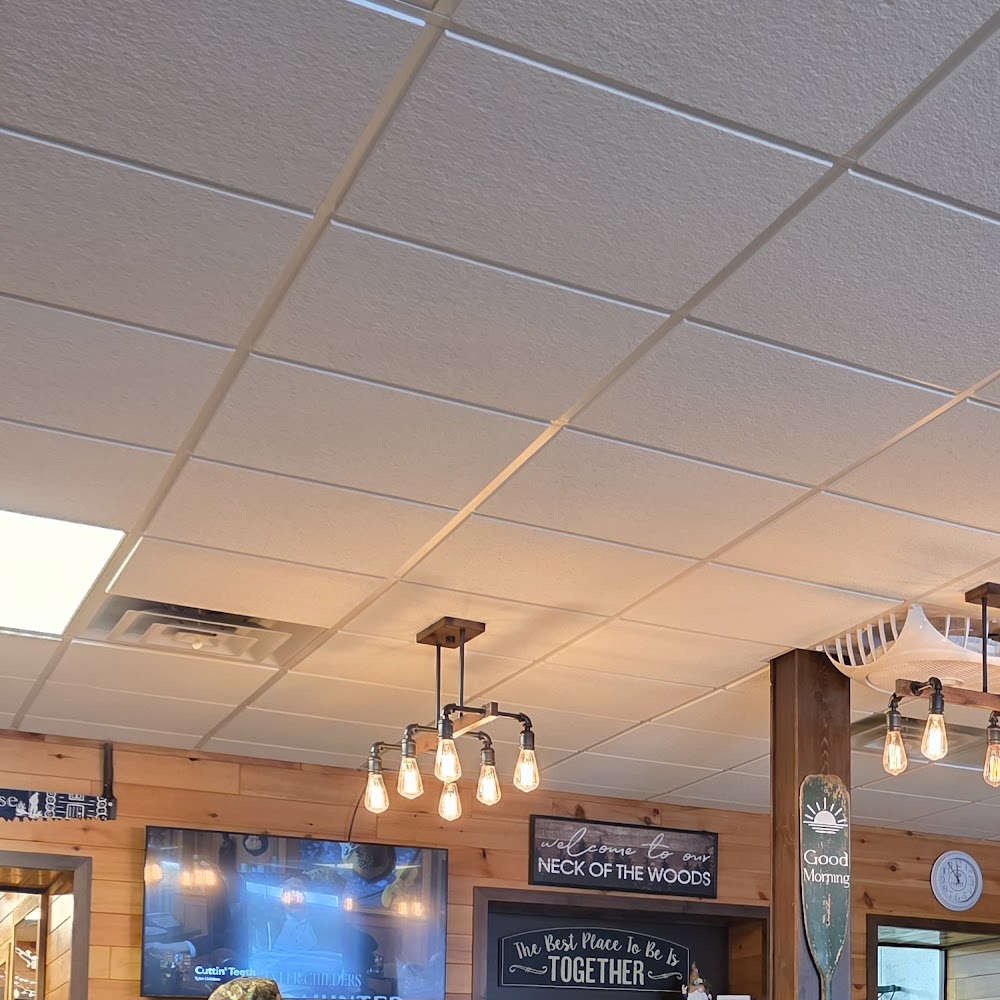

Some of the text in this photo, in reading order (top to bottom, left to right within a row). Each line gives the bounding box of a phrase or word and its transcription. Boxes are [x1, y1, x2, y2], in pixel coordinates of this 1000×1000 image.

[540, 827, 711, 863] welcome to our
[803, 849, 849, 867] Good
[538, 857, 711, 887] NECK OF THE WOODS
[803, 867, 850, 889] Morning
[513, 931, 680, 967] The Best Place To Be Is
[194, 965, 256, 977] Cuttin' Teeth
[547, 955, 645, 986] TOGETHER
